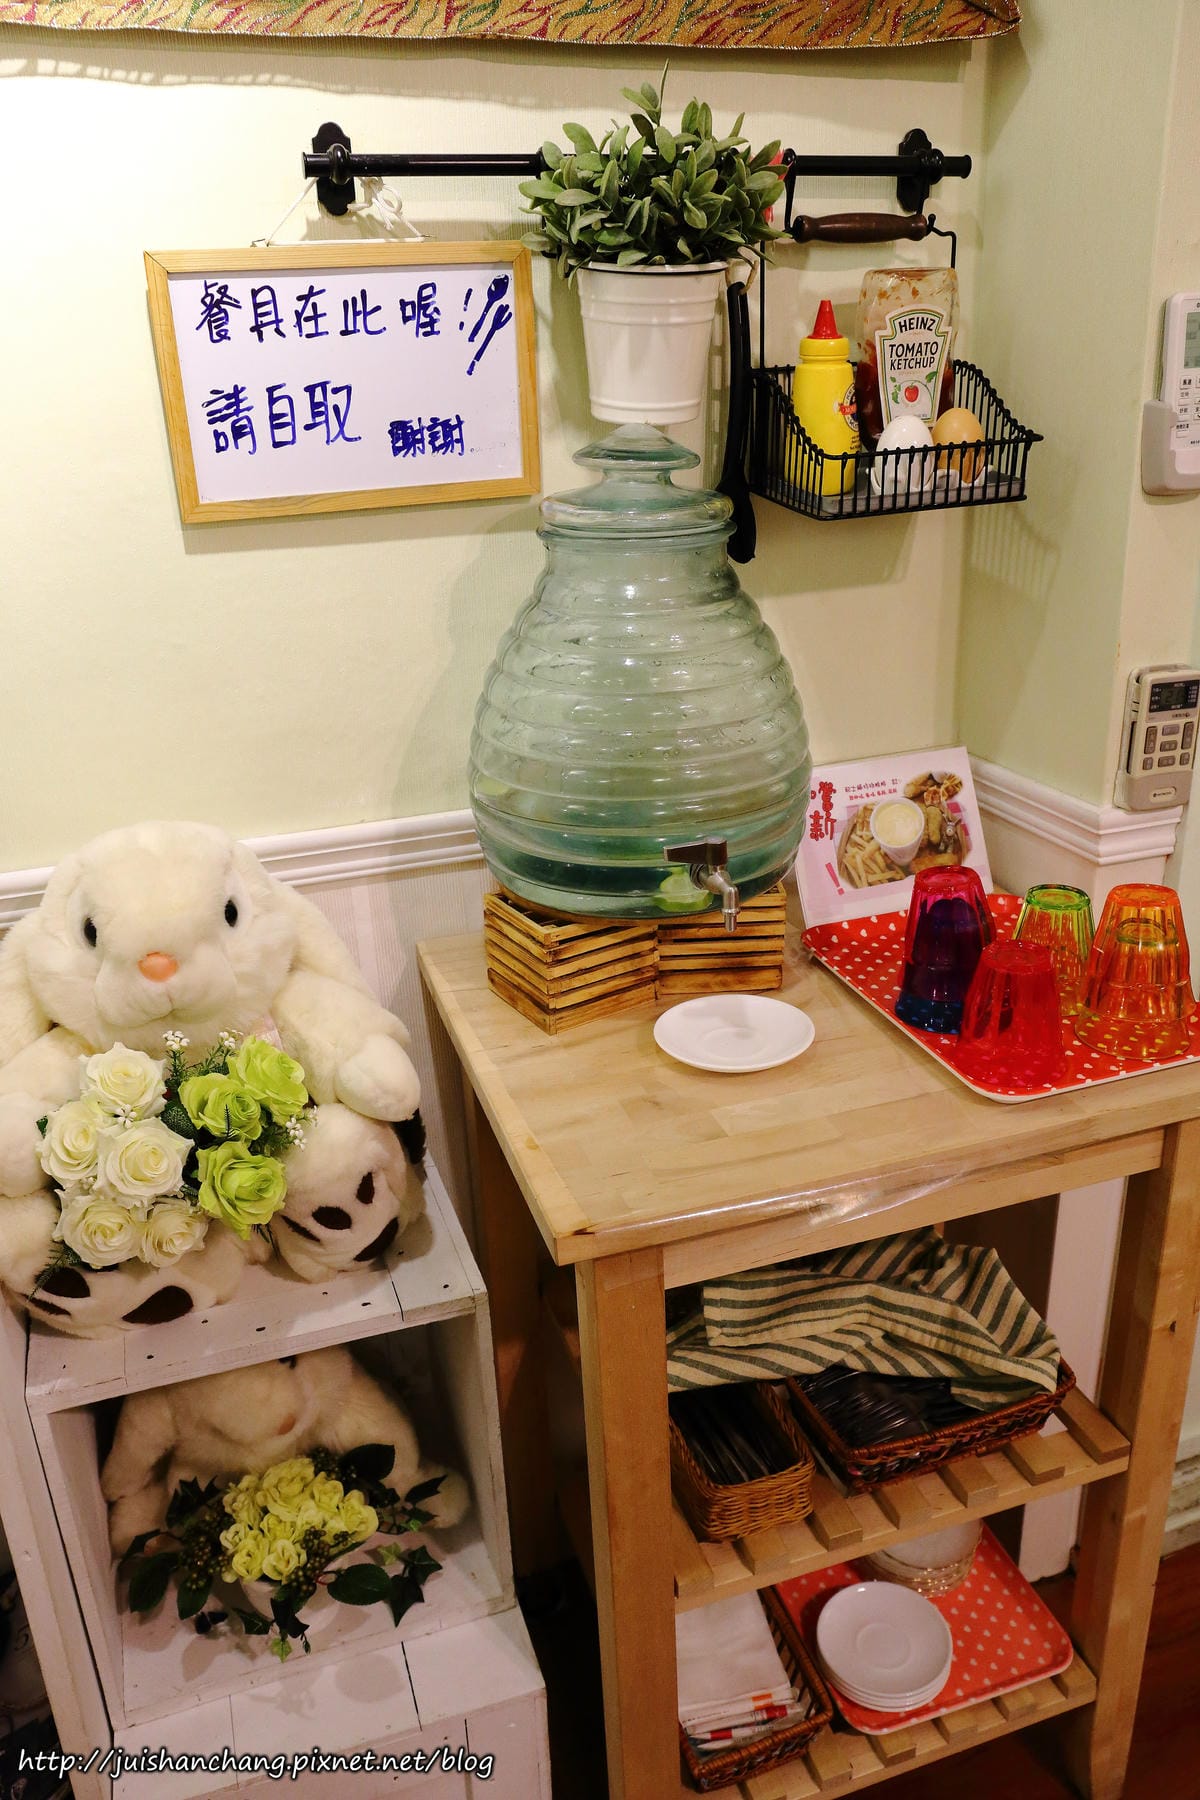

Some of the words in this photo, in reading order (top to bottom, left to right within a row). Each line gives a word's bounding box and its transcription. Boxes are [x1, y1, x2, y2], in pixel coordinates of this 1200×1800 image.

[898, 316, 936, 333] HEINZ
[888, 341, 939, 359] TOMATO
[889, 356, 936, 371] KETCHUP
[201, 379, 362, 455] 請自取
